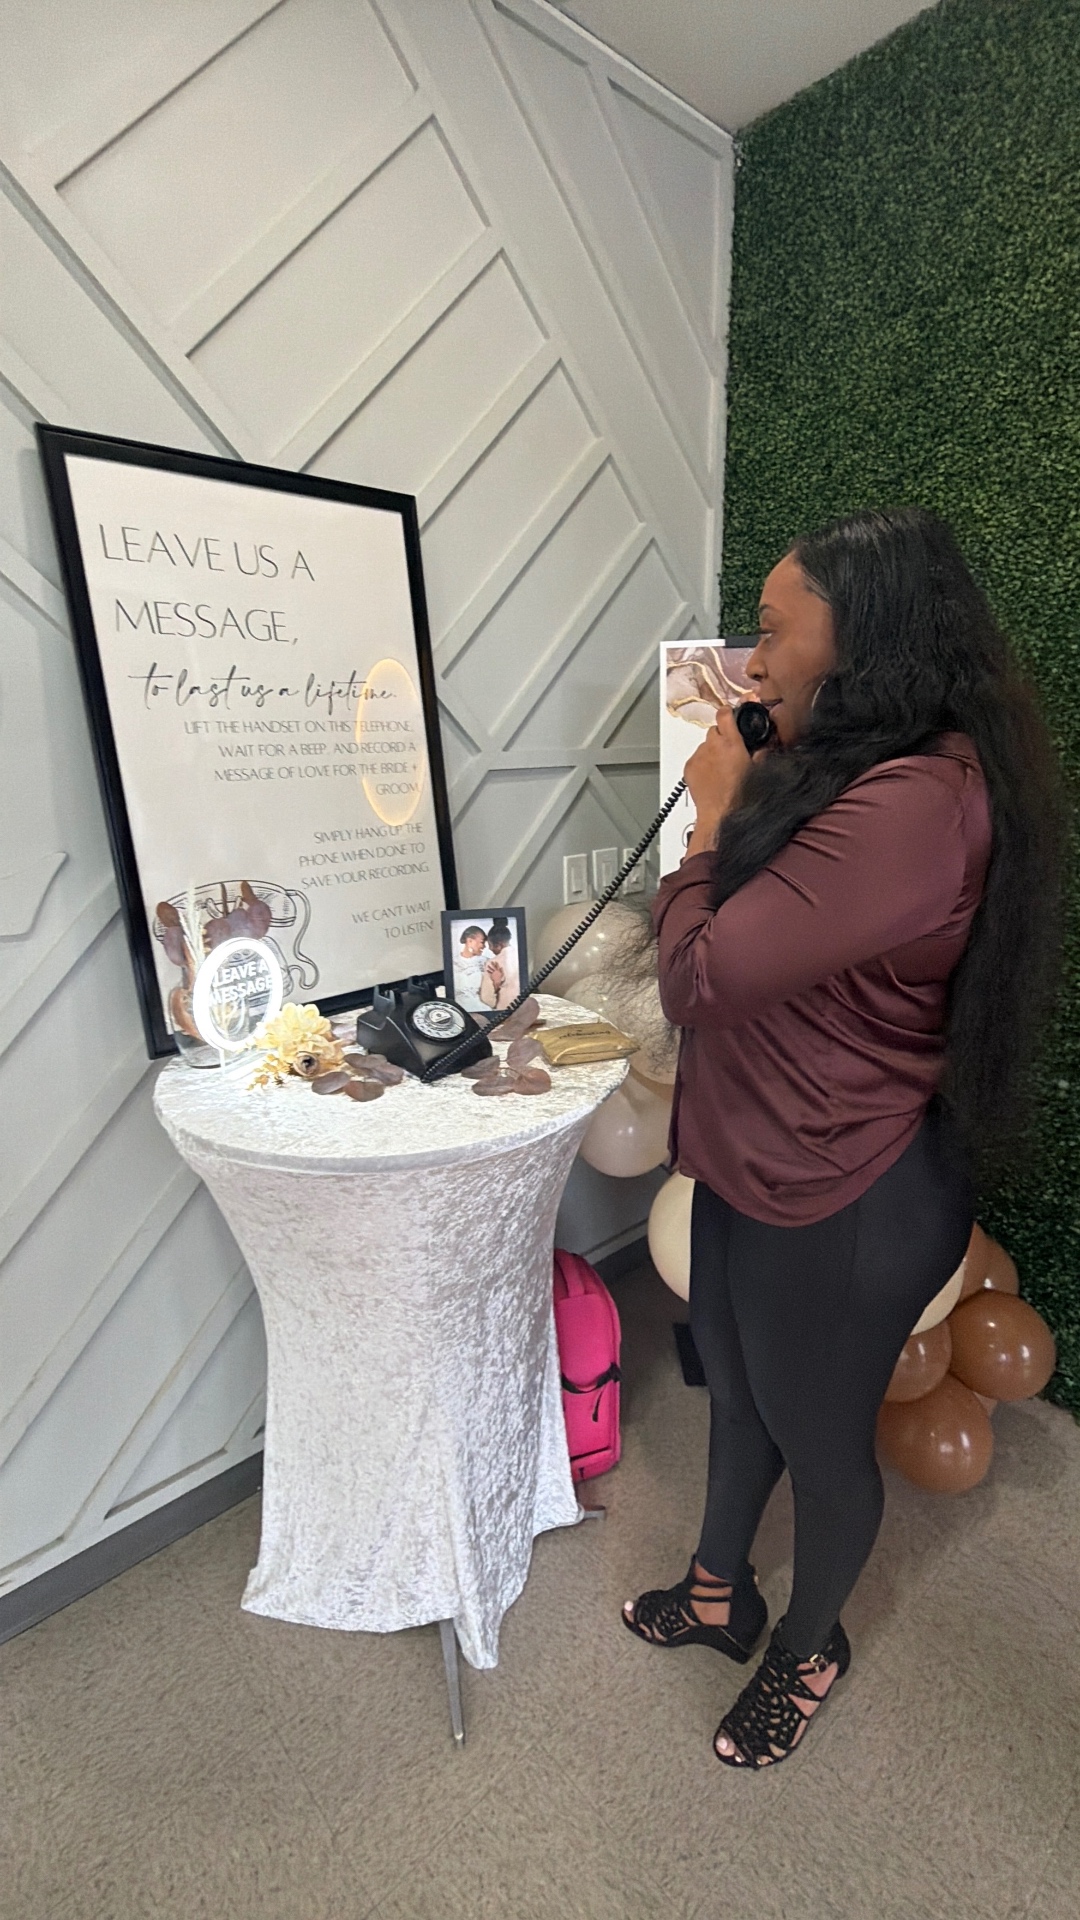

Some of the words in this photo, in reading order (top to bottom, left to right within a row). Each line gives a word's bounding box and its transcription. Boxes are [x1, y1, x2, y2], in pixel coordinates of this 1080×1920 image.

[99, 523, 225, 572] LEAVE
[234, 541, 279, 579] US
[291, 550, 315, 582] A
[115, 598, 298, 645] MESSAGE,
[128, 662, 173, 710] to
[175, 664, 251, 710] last
[241, 685, 274, 708] us
[184, 720, 209, 734] LIFT
[216, 720, 240, 734] THE
[242, 720, 300, 734] HANDSET
[304, 720, 326, 733] ON
[328, 720, 352, 733] THIS
[218, 744, 254, 758] WAIT
[258, 743, 286, 757] FOR
[288, 744, 299, 756] A
[333, 742, 359, 755] AND
[361, 741, 406, 754] RECORD
[408, 742, 417, 753] A
[214, 767, 275, 781] MESSAGE
[278, 766, 295, 779] OF
[298, 764, 329, 779] LOVE
[333, 763, 358, 777] FOR
[358, 762, 379, 775] THE
[380, 761, 408, 775] BRIDE
[313, 829, 353, 844] SIMPLY
[355, 825, 387, 840] HANG
[389, 824, 403, 837] UP
[404, 822, 423, 834] THE
[299, 851, 339, 867] PHONE
[340, 847, 375, 862] WHEN
[376, 844, 406, 858] DONE
[410, 842, 426, 854] TO
[301, 874, 333, 890] SAVE
[333, 869, 368, 884] YOUR
[352, 910, 370, 924] WE
[405, 900, 432, 915] WAIT
[384, 926, 400, 939] TO
[212, 960, 257, 988] LEAVE
[258, 957, 270, 975] A
